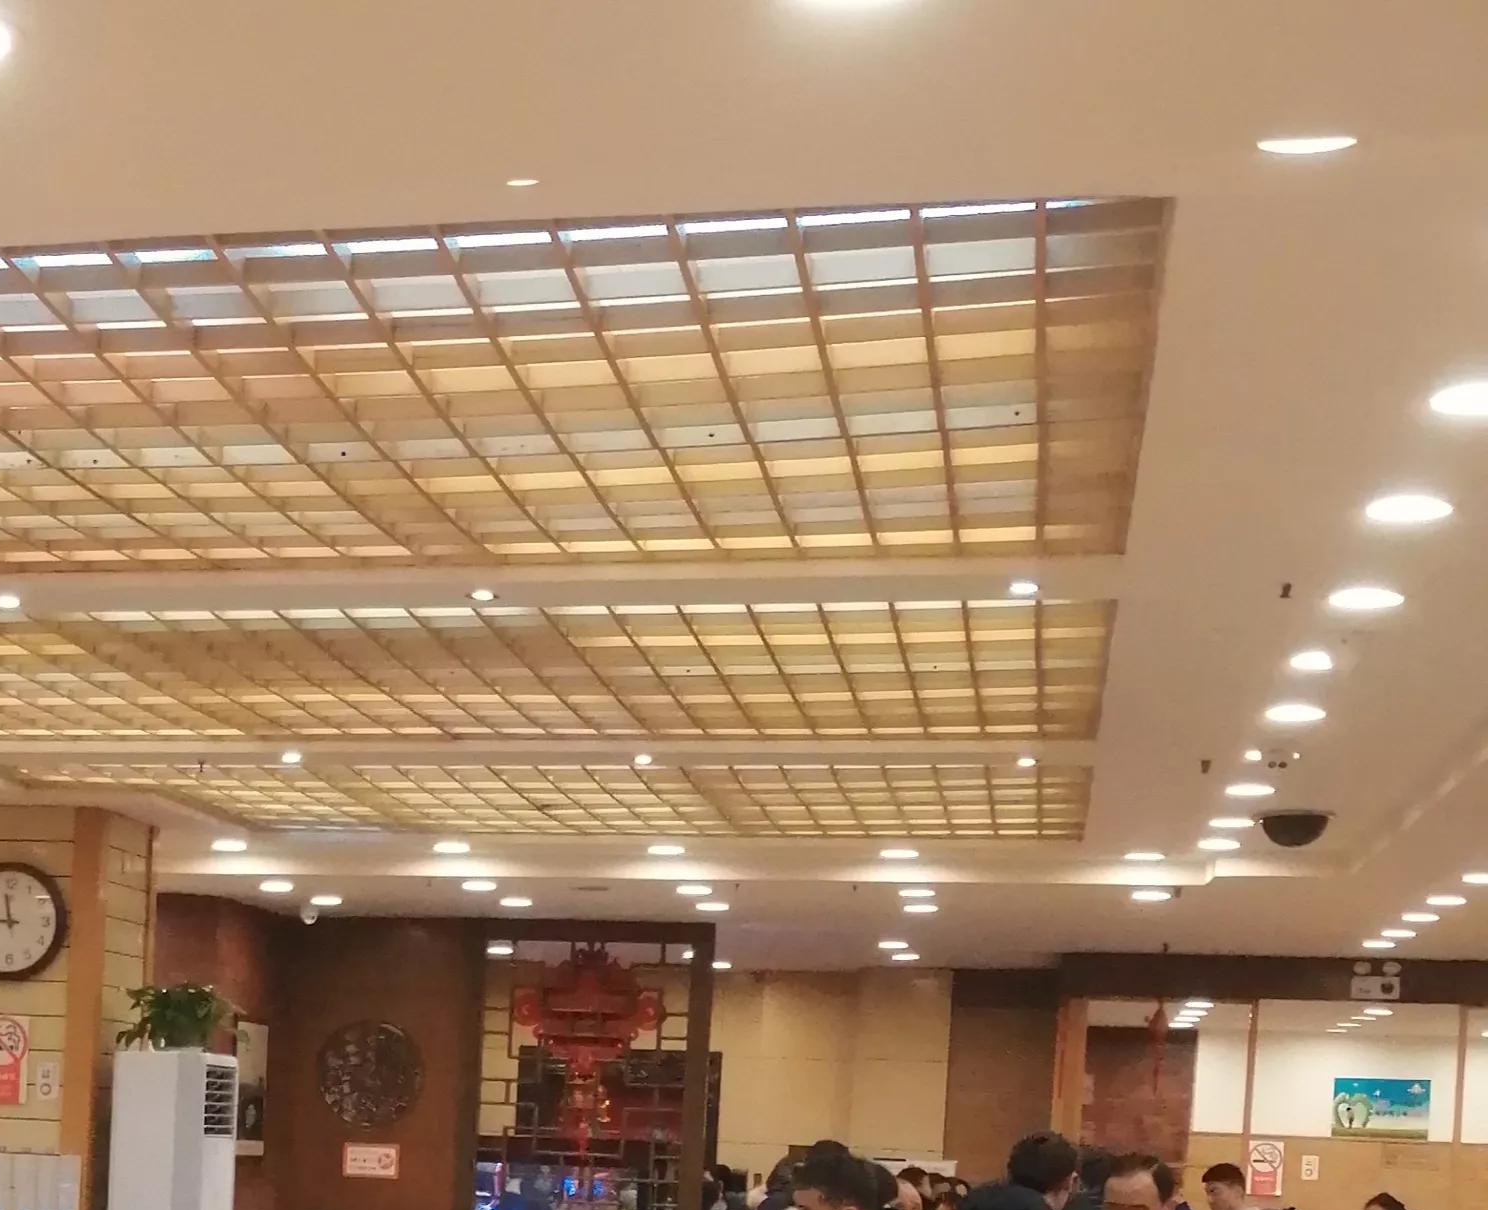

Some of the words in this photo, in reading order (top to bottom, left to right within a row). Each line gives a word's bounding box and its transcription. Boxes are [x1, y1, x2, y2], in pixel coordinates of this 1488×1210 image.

[6, 879, 18, 890] 12
[42, 916, 51, 928] 3
[36, 935, 45, 946] 4
[5, 954, 14, 965] 6
[23, 948, 32, 960] 5
